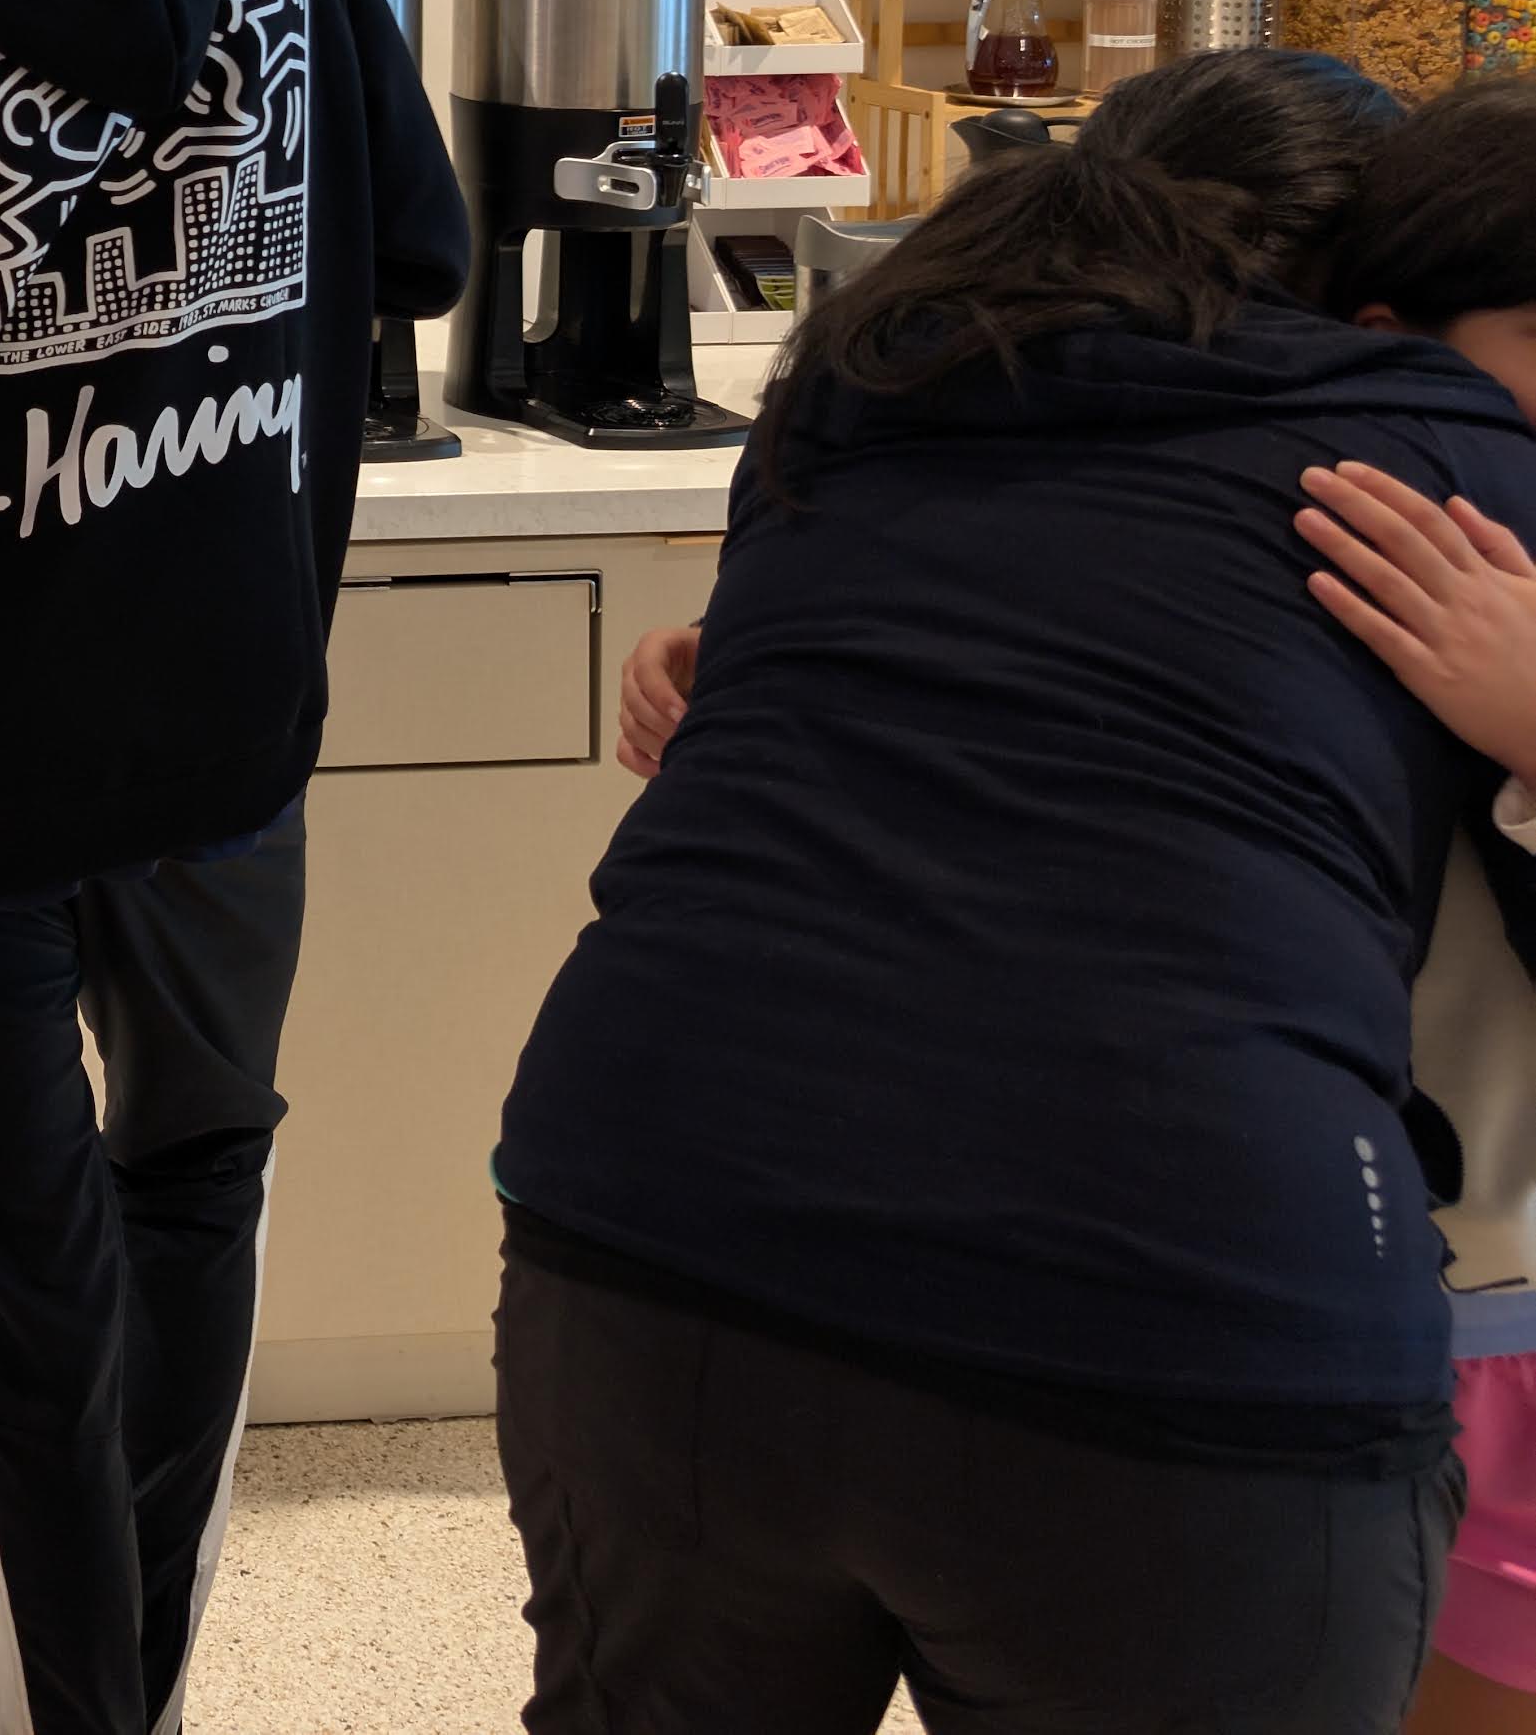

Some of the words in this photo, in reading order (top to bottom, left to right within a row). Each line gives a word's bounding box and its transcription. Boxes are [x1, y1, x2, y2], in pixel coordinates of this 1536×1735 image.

[0, 350, 30, 363] THE
[36, 339, 86, 358] LOWER
[96, 329, 128, 349] EAST
[217, 298, 256, 314] MARKS
